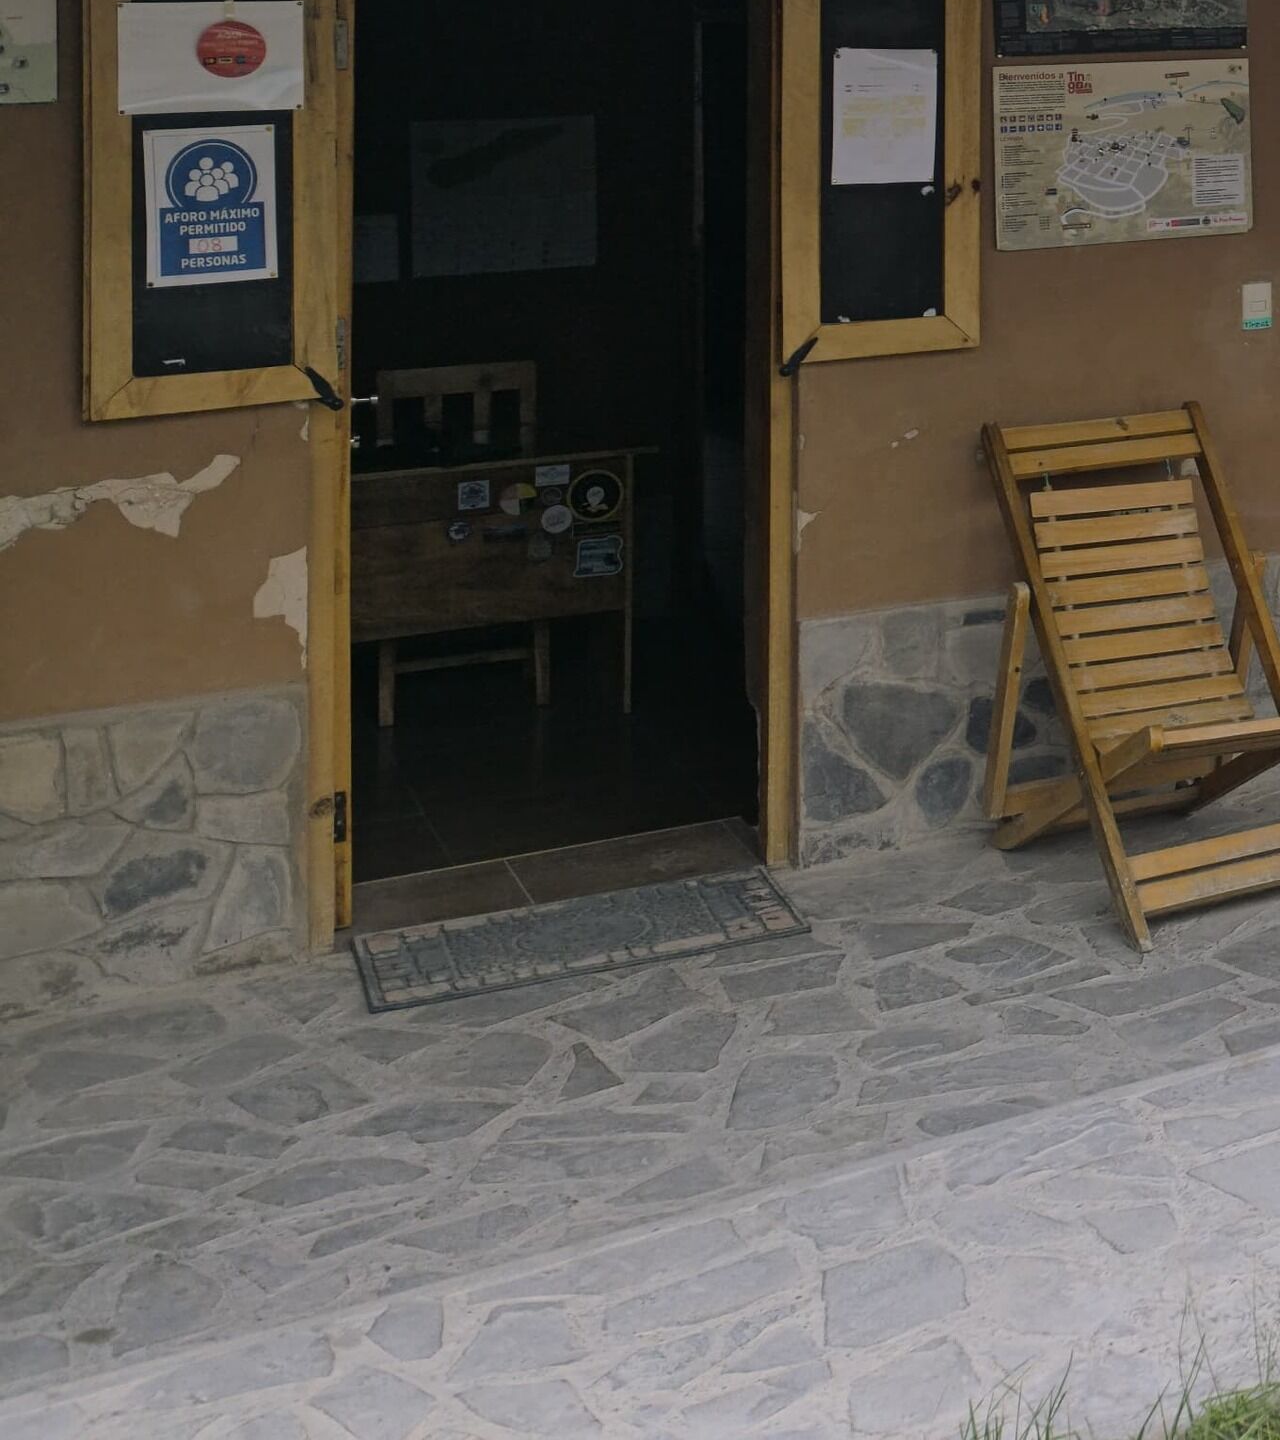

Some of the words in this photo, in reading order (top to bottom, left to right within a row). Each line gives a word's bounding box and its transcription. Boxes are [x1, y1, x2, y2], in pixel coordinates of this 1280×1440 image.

[999, 72, 1056, 81] Bienvenidos
[164, 211, 207, 224] AFORO
[210, 207, 260, 221] MÁXIMO
[179, 221, 246, 236] PERMITIDO
[181, 254, 247, 269] PERSONAS
